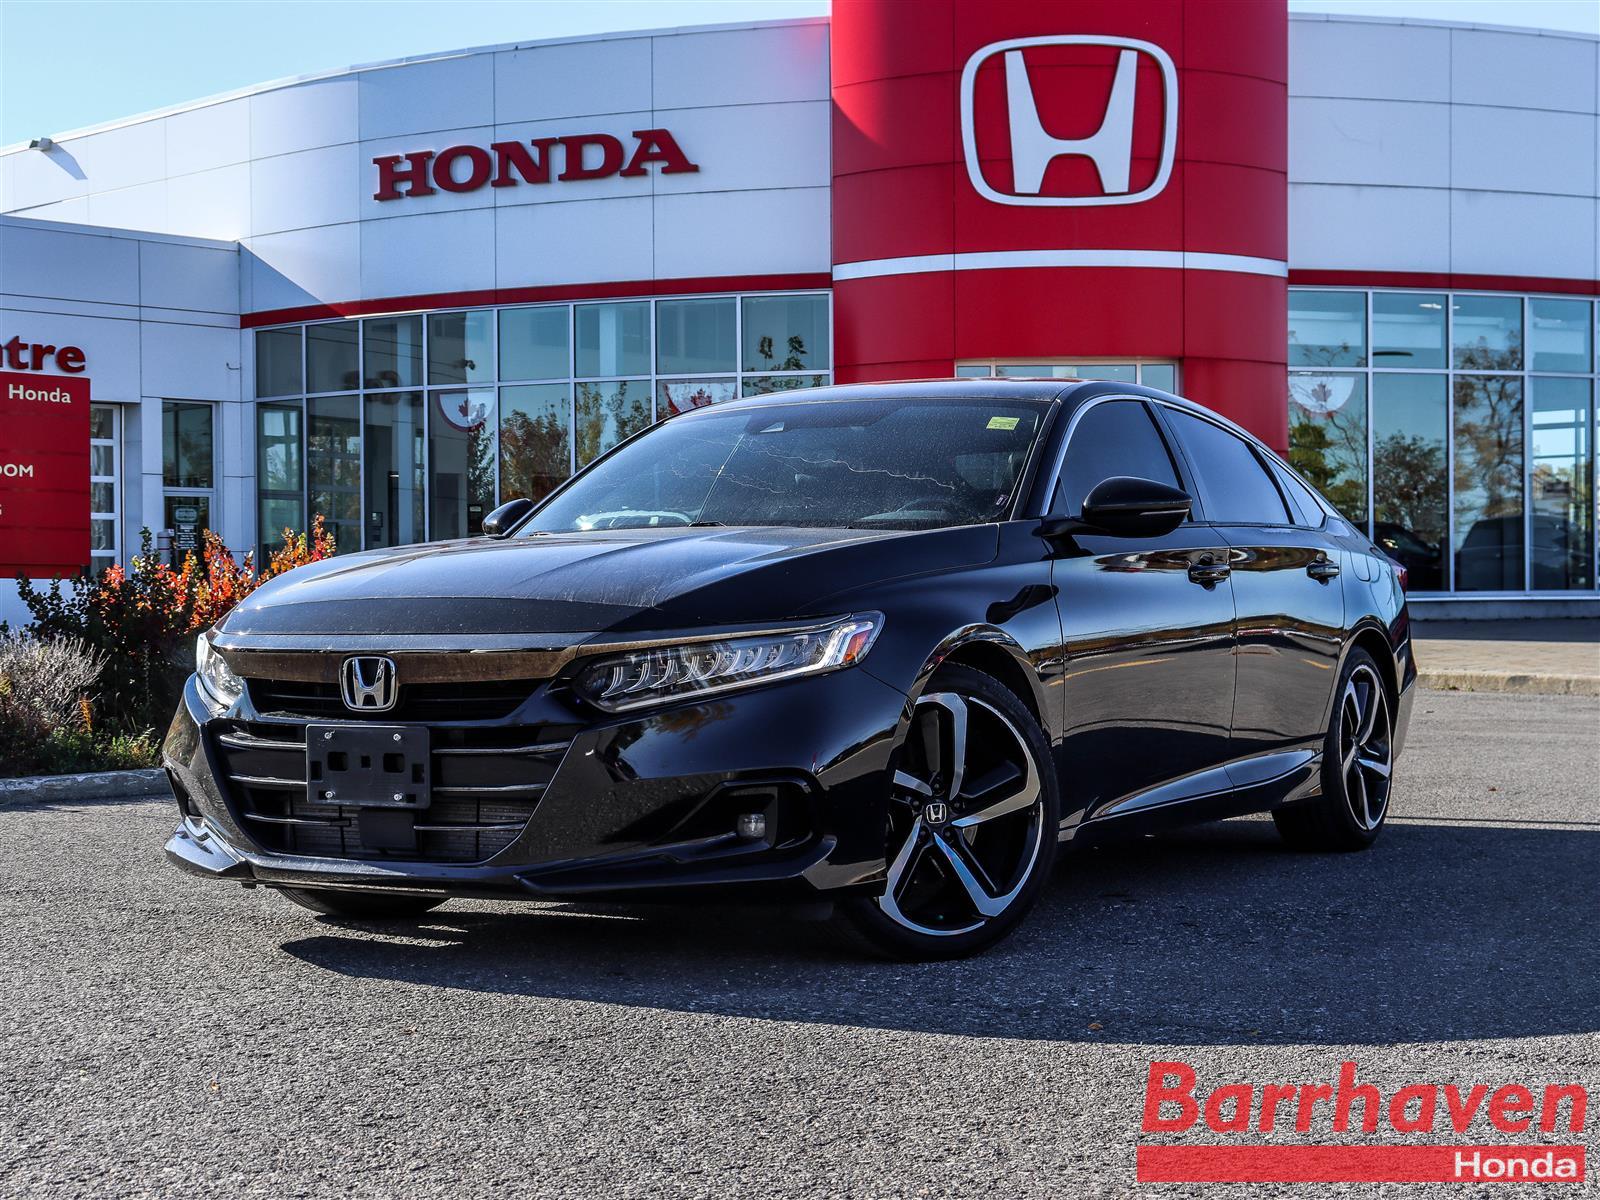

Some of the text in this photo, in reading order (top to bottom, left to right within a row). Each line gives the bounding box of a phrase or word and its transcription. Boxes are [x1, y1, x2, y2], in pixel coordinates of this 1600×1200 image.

[373, 128, 699, 201] HONDA
[0, 335, 86, 373] tre
[8, 383, 71, 403] Honda
[0, 463, 34, 478] OM
